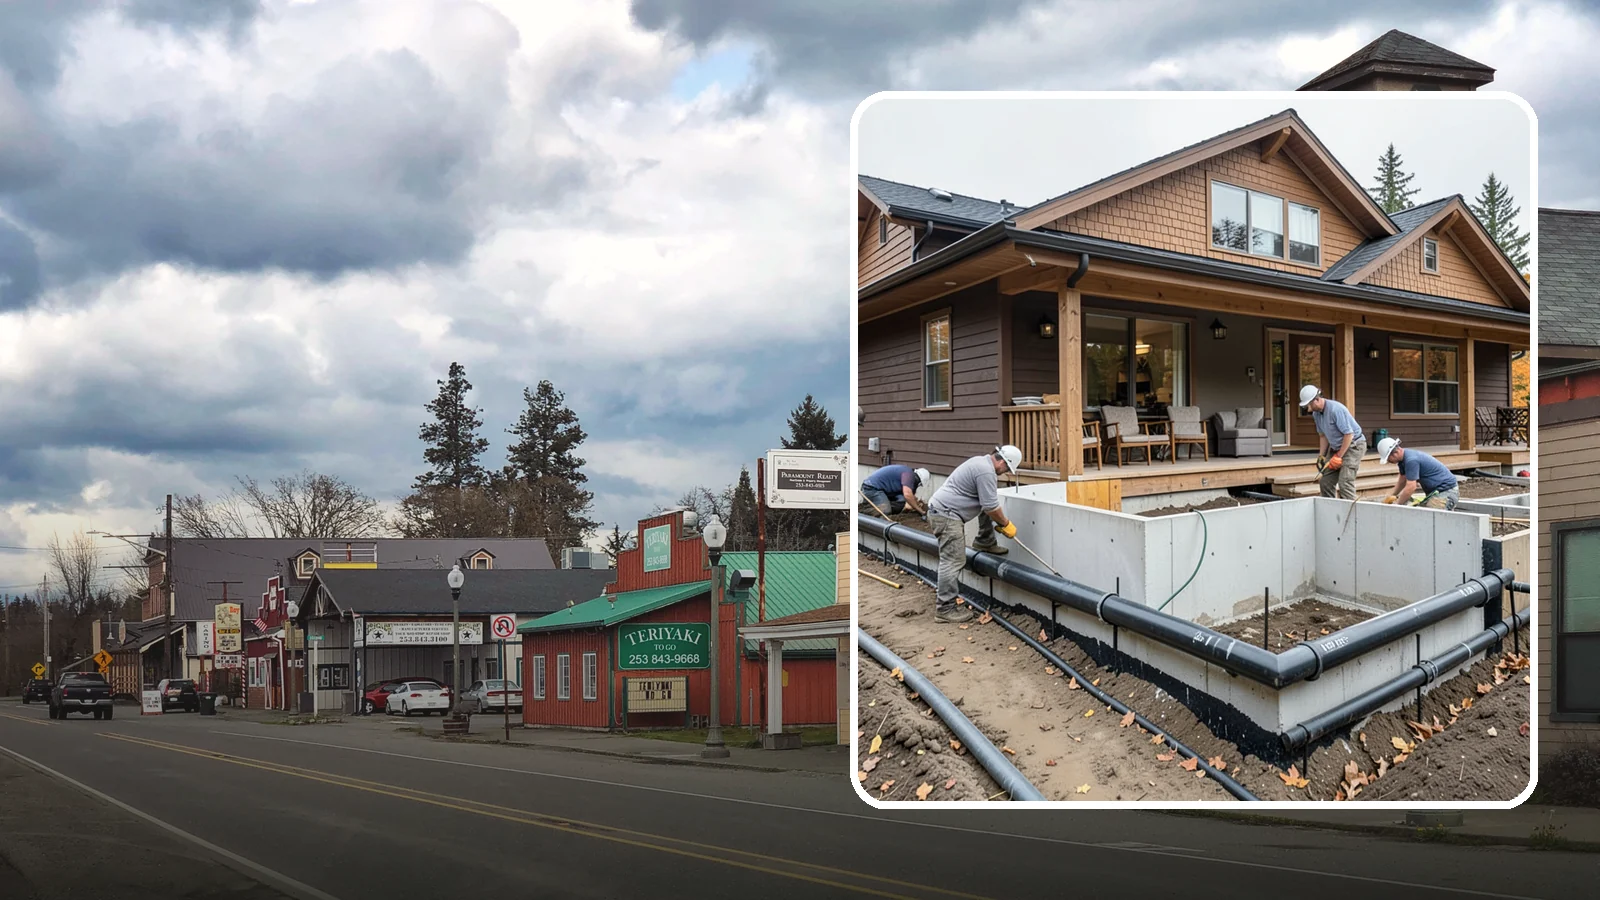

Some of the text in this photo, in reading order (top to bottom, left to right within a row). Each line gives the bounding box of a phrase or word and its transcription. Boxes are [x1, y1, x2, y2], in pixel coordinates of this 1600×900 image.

[781, 471, 839, 480] PARAMOUNT REALTY
[646, 531, 668, 549] TERIYAKI
[624, 627, 703, 646] TERIYAKI
[628, 654, 700, 665] 253 843-9668
[639, 681, 672, 690] TERIYAKI
